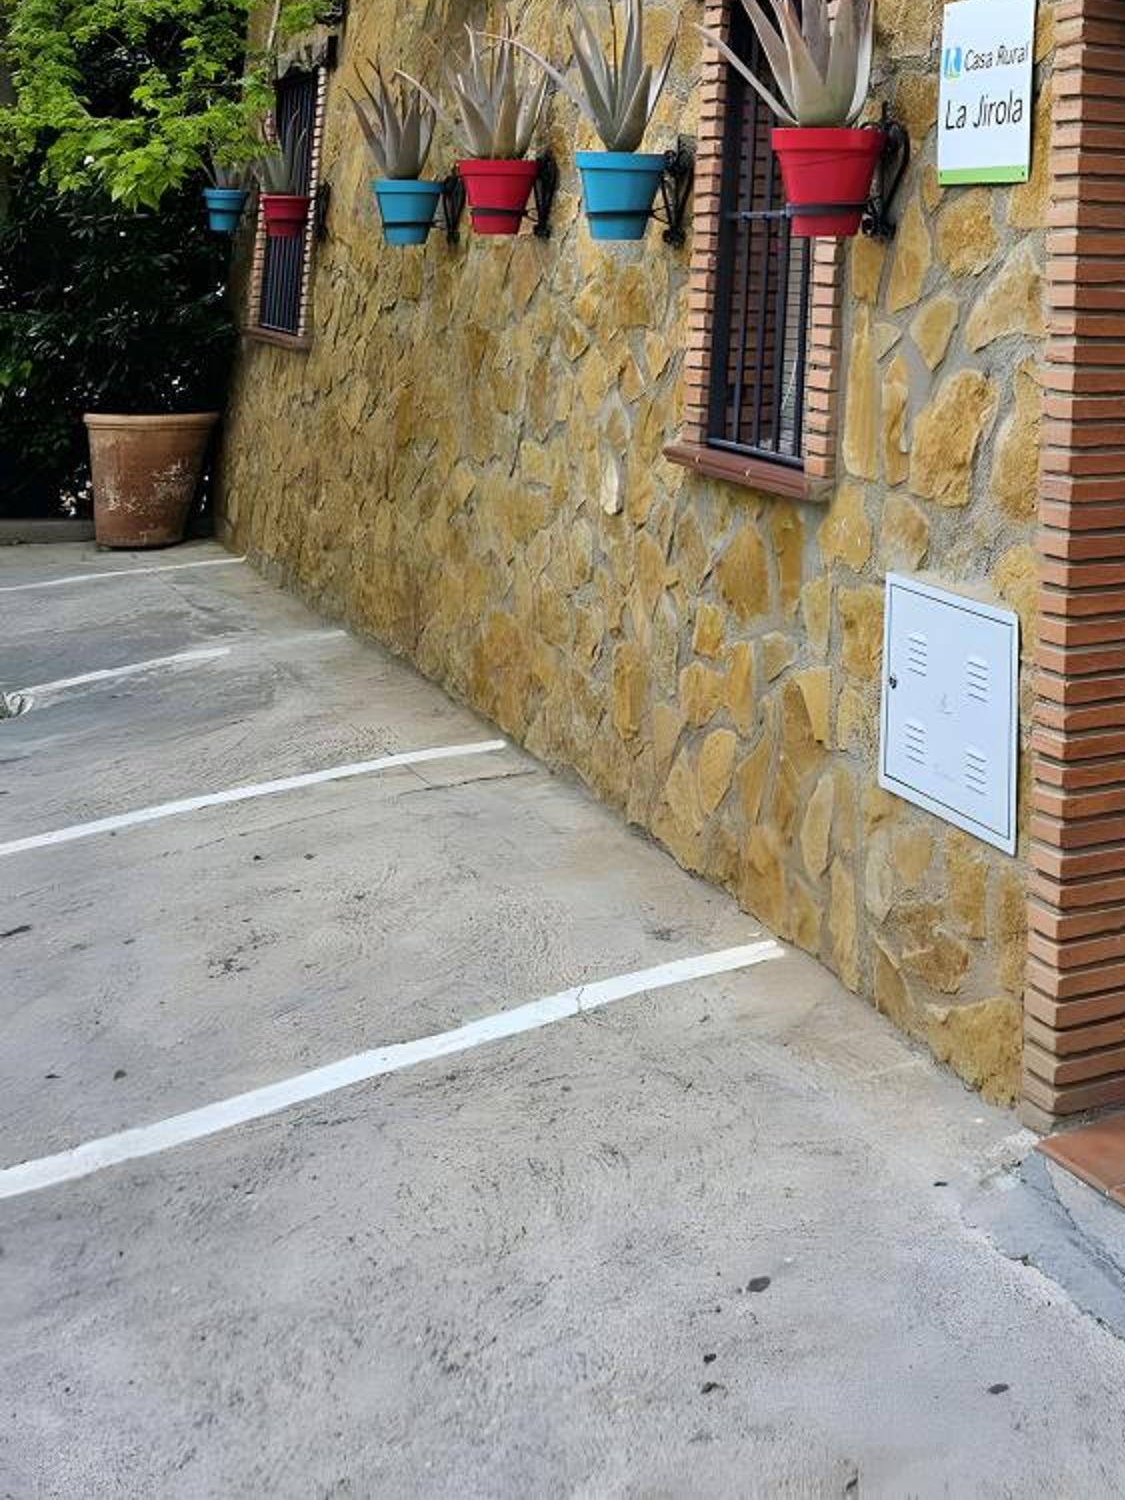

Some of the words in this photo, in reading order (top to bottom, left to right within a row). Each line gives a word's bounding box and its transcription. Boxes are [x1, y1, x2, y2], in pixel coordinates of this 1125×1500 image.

[963, 49, 993, 72] Casa
[995, 41, 1030, 67] Rural
[945, 99, 967, 130] La
[972, 89, 1024, 129] Jirola
